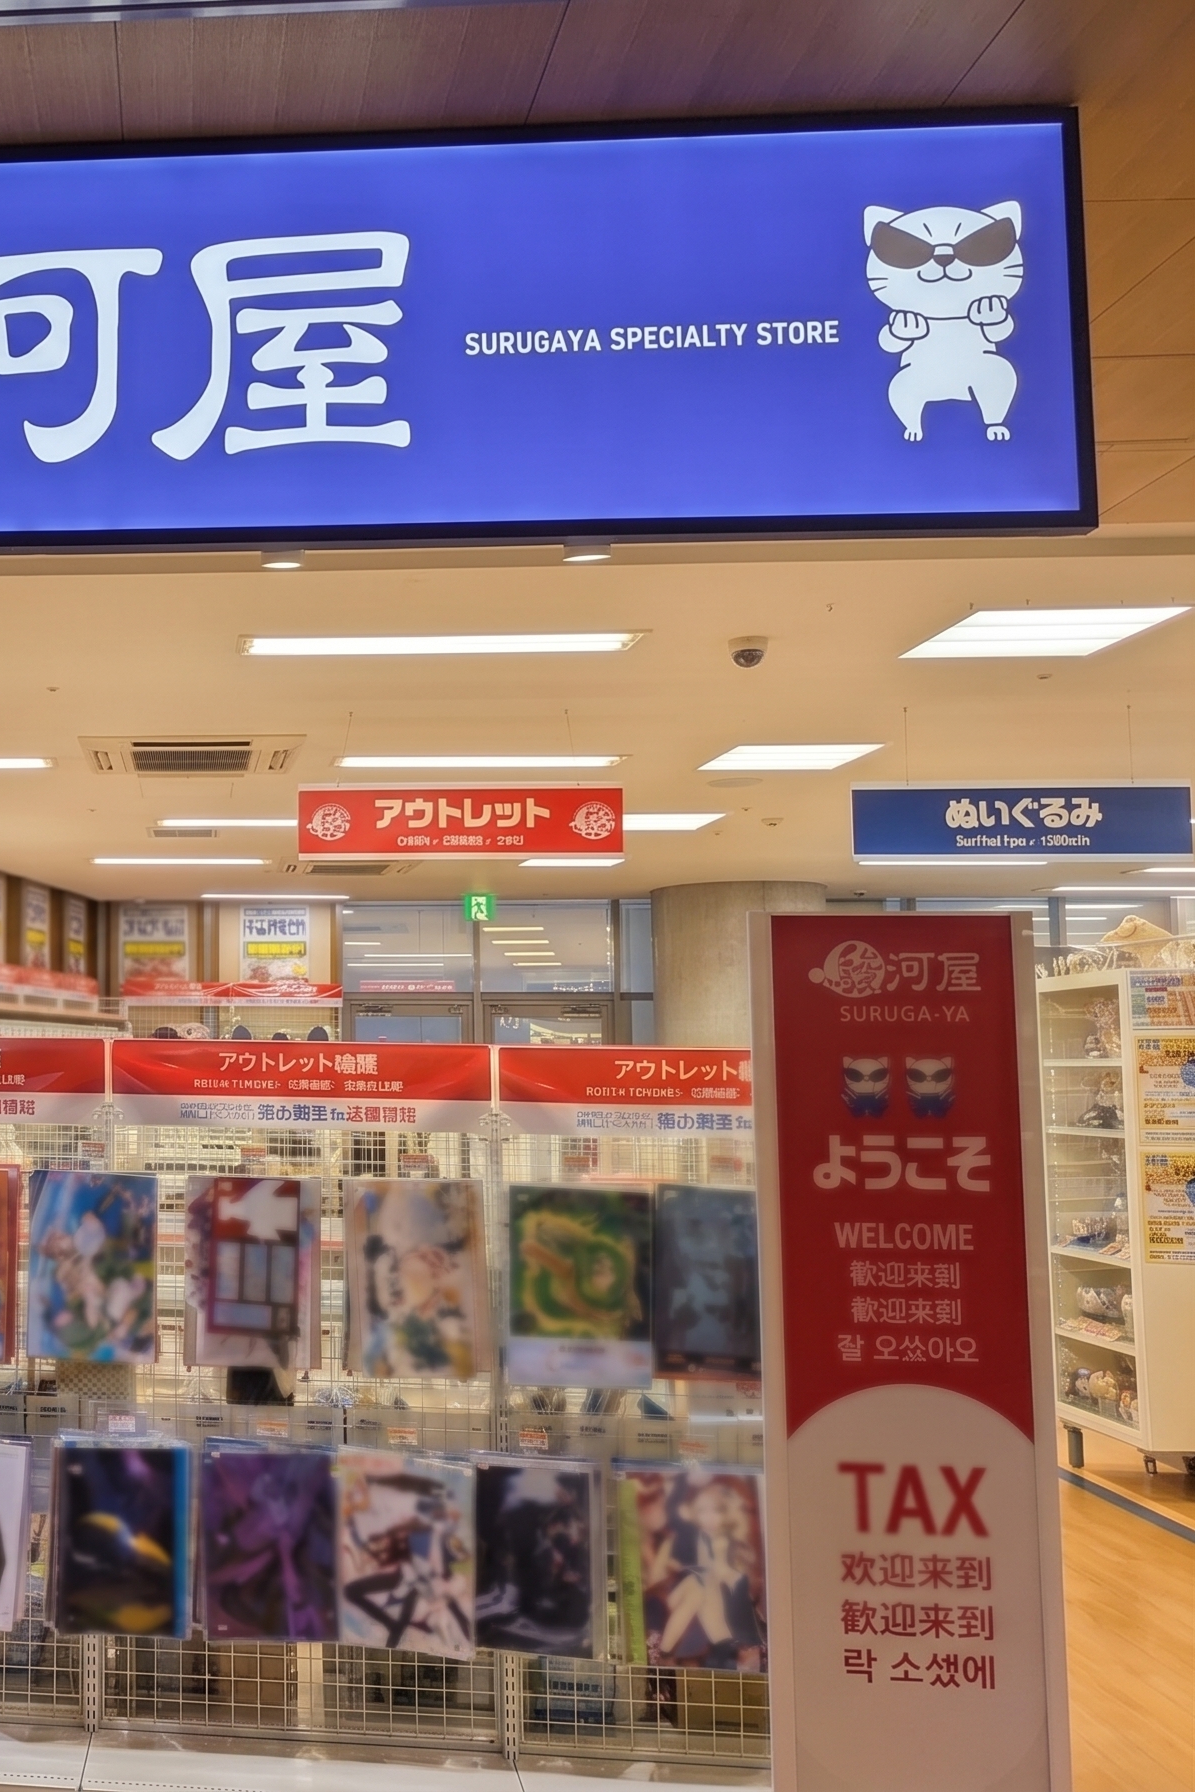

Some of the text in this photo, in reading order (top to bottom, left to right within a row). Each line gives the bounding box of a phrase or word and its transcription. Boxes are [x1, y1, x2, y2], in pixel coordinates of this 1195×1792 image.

[464, 320, 840, 356] SURUGAYA SPECIALTY STORE
[374, 797, 551, 829] アウトレット
[945, 797, 1103, 829] ぬいぐるみ
[808, 939, 982, 999] 駿河屋
[839, 1005, 971, 1023] SURUGA-YA
[812, 1134, 992, 1193] ようこそ
[833, 1221, 975, 1251] WELCOME
[837, 1460, 990, 1538] TAX
[841, 1551, 992, 1591] 欢迎来到
